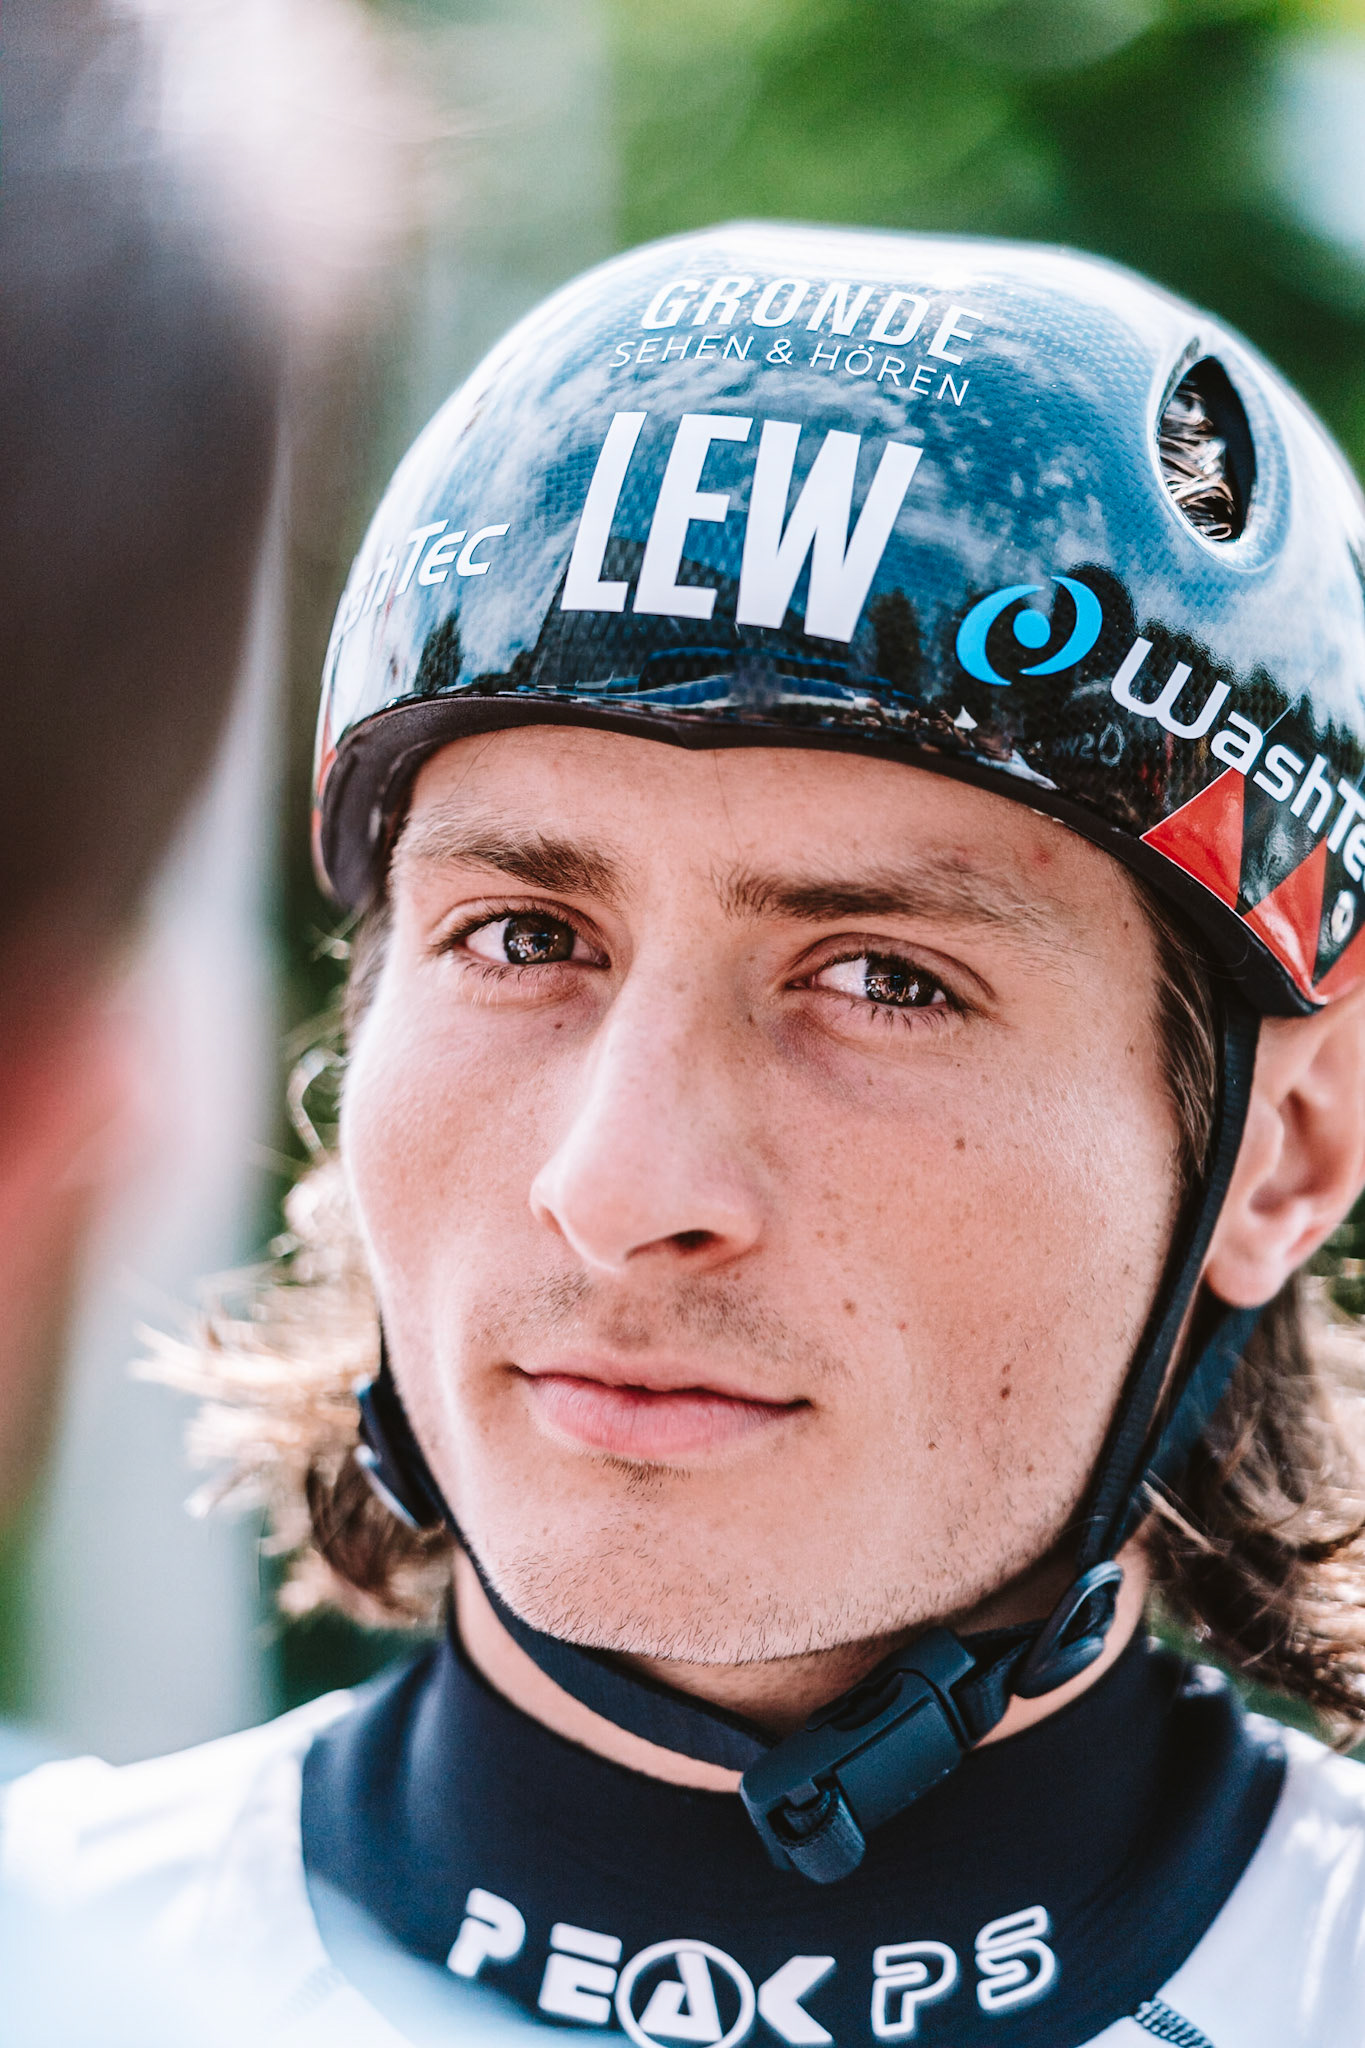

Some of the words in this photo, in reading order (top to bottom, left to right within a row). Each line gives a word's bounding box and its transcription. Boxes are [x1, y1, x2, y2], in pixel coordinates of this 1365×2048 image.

[609, 334, 755, 368] SEHEN
[766, 338, 794, 366] &
[809, 343, 971, 407] HÖREN
[640, 275, 985, 366] GRONDE
[560, 410, 924, 643] LEW
[1110, 636, 1365, 884] WashTe
[446, 1886, 836, 2048] PEAK
[871, 1904, 1056, 2038] PS
